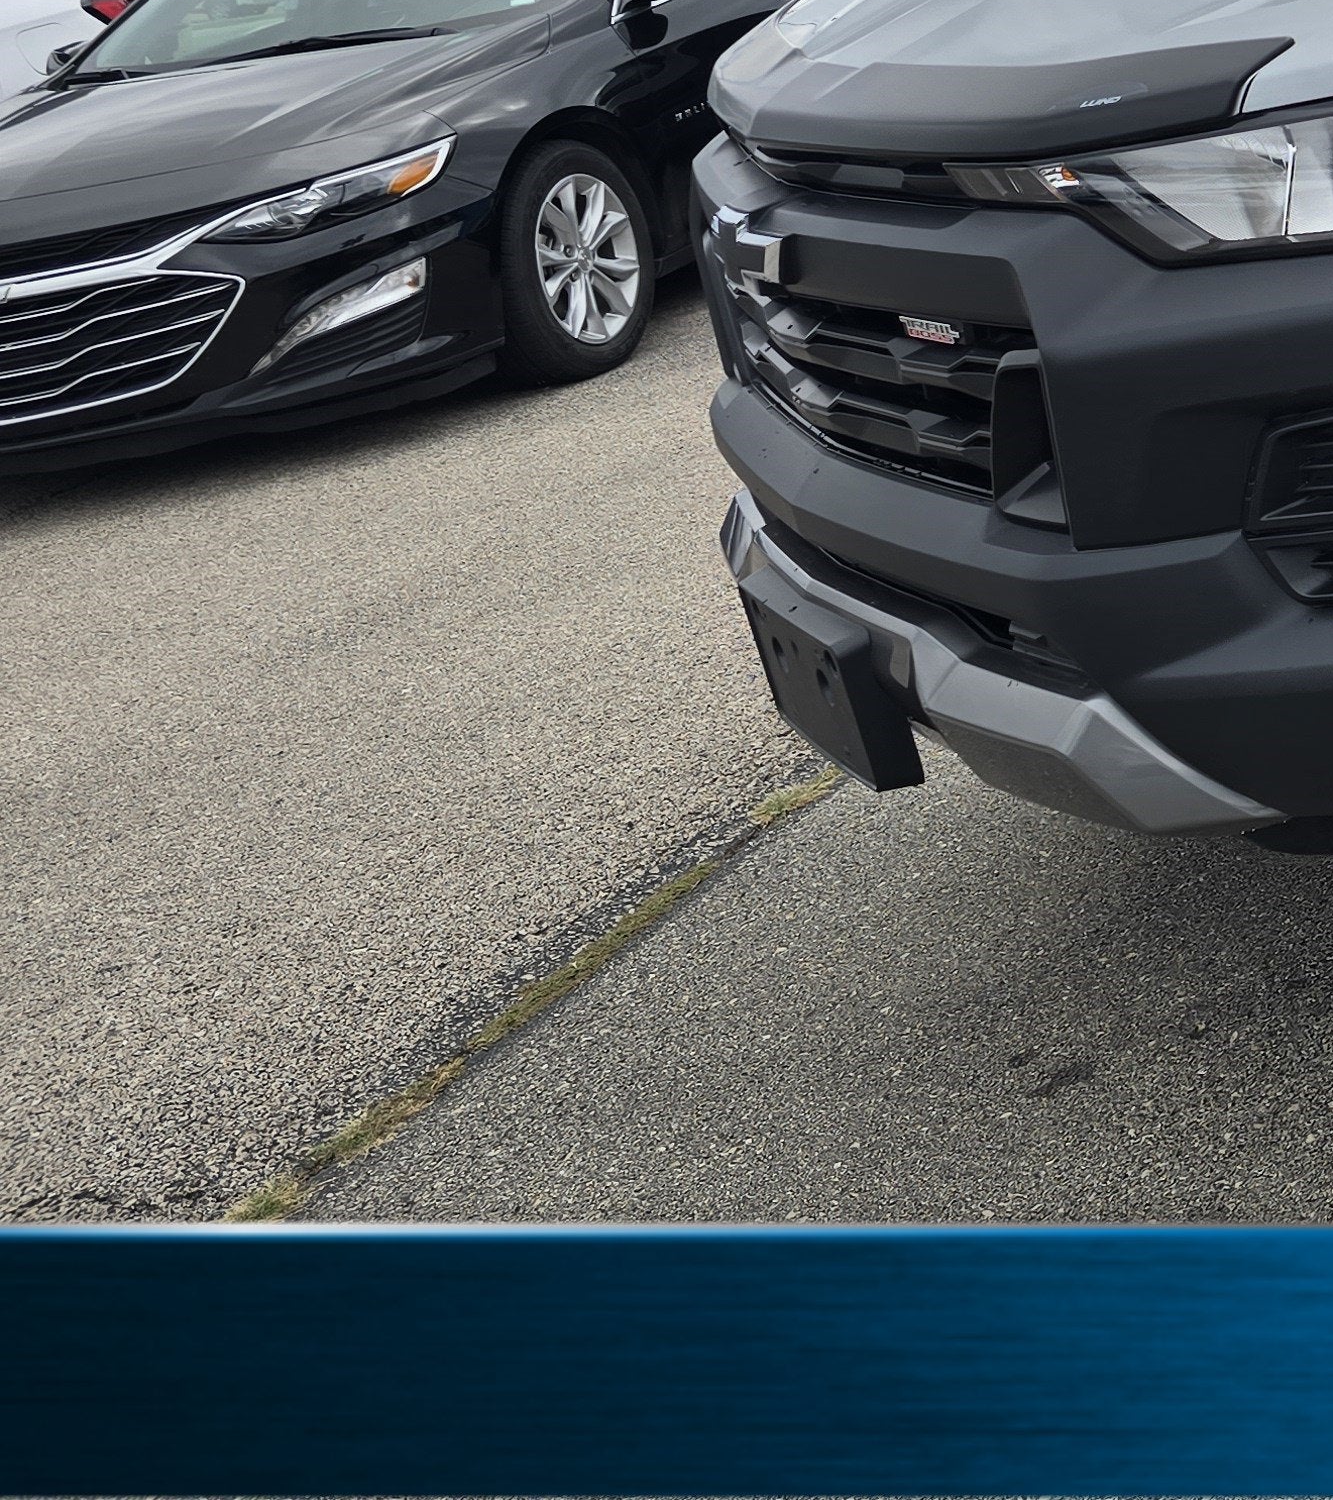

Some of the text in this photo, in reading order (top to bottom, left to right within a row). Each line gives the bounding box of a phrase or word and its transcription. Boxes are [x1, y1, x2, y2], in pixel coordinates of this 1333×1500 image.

[1079, 95, 1122, 108] LUND
[898, 315, 960, 339] TRAIL
[908, 327, 956, 345] BOSS
